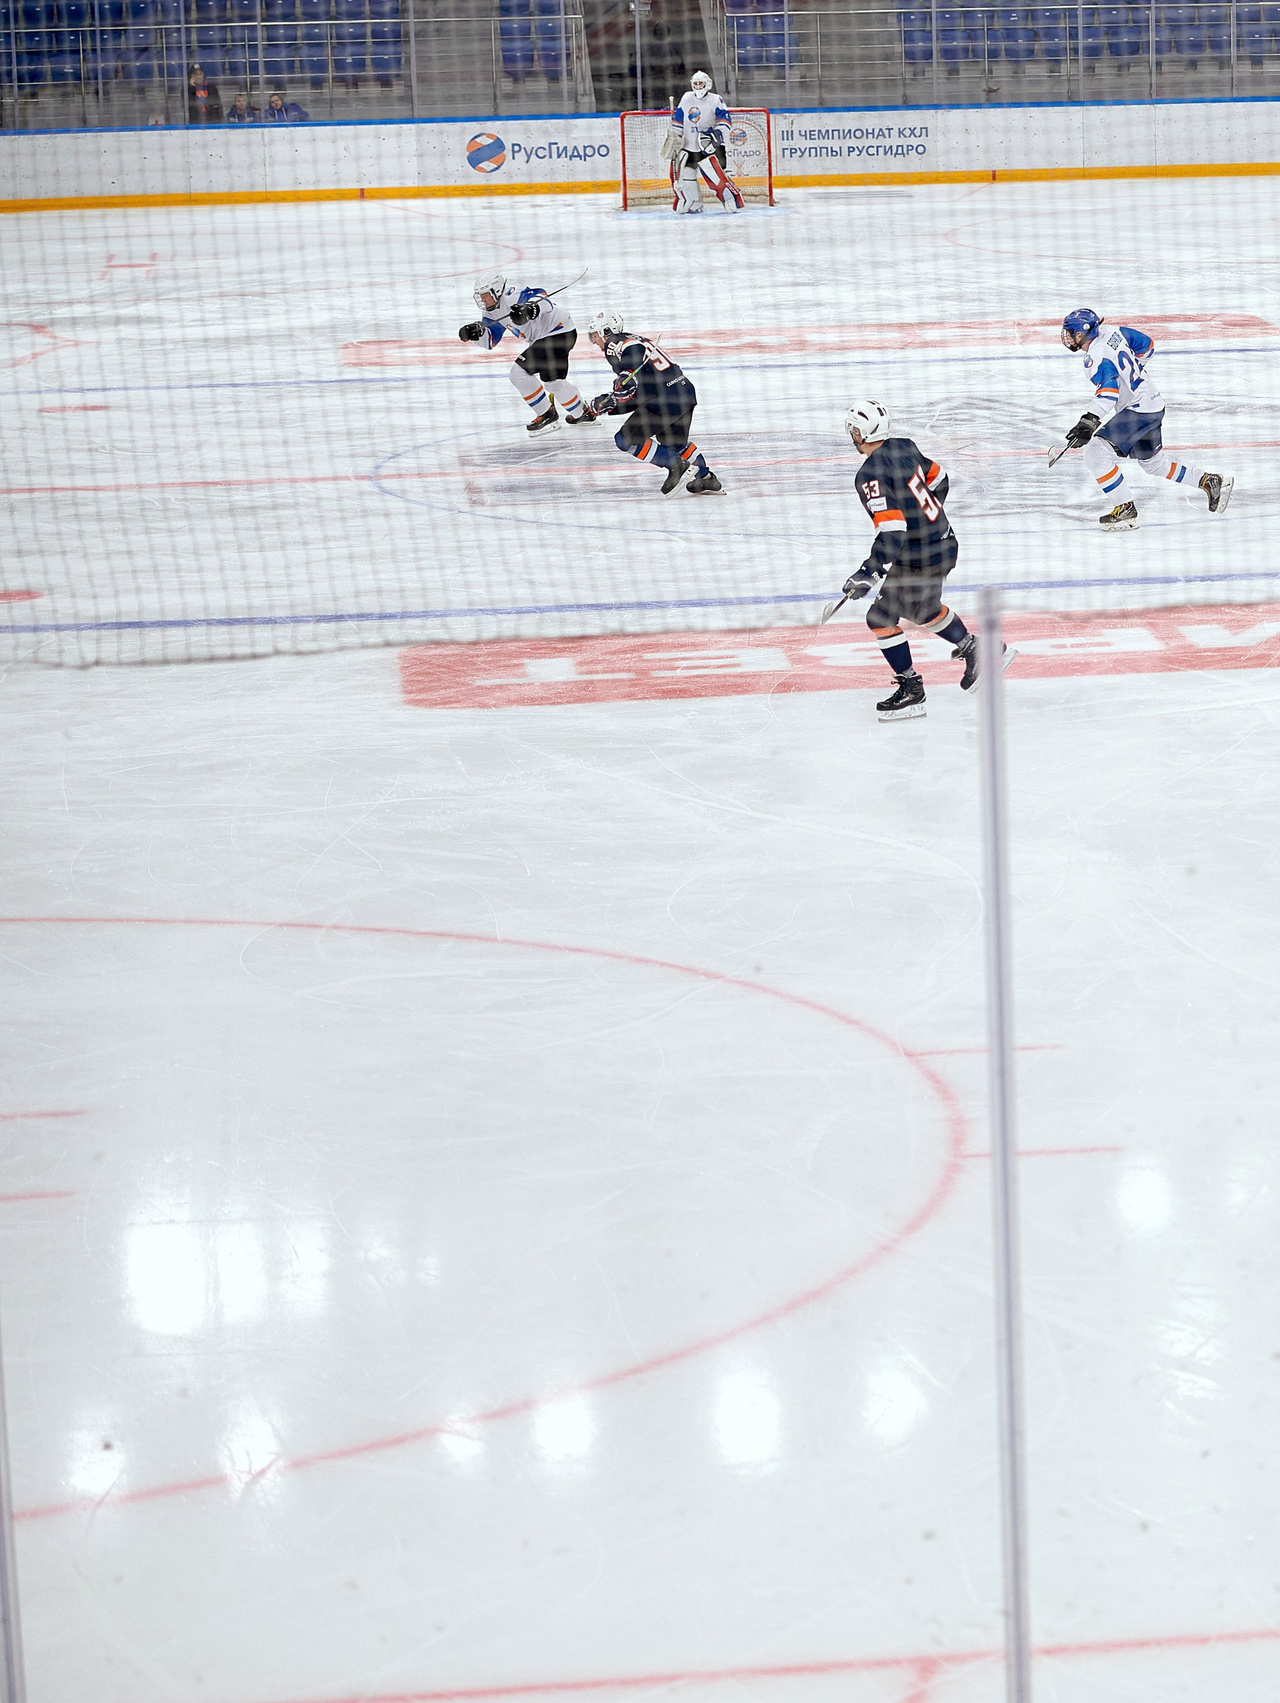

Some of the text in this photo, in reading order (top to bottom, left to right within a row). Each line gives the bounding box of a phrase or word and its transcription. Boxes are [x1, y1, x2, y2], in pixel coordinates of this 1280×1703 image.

[798, 127, 894, 141] ЧЕМПИОНАТ
[898, 126, 929, 139] КХЛ
[511, 142, 610, 164] РусГидро
[726, 148, 761, 158] сГидро
[782, 143, 927, 158] ГРУППЫ РУСГИДРО
[606, 341, 618, 357] 90
[861, 479, 881, 501] 53
